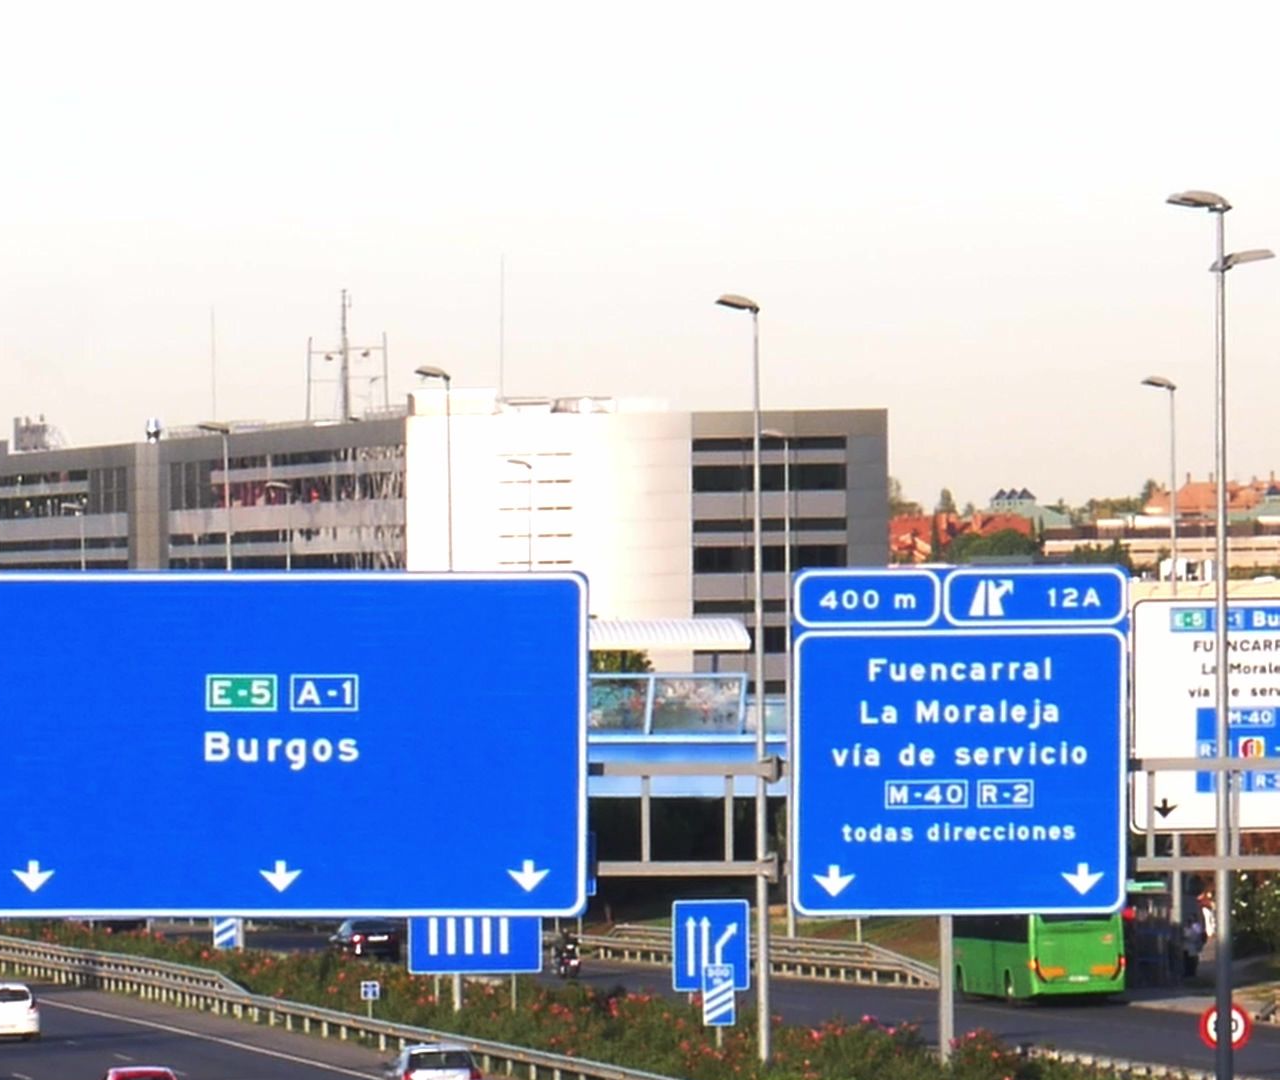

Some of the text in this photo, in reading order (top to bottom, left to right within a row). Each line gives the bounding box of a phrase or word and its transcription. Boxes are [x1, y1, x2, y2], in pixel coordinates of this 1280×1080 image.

[820, 590, 916, 609] 400 m
[1049, 588, 1100, 608] 12A
[868, 658, 1051, 682] Fuencarral
[212, 680, 353, 705] E-5 A-1
[860, 700, 1059, 729] La Moraleja
[204, 732, 359, 771] Burgos
[833, 742, 1087, 767] vía de servicio
[889, 784, 1029, 805] M-40 R-2
[842, 825, 1075, 842] todas direcciones
